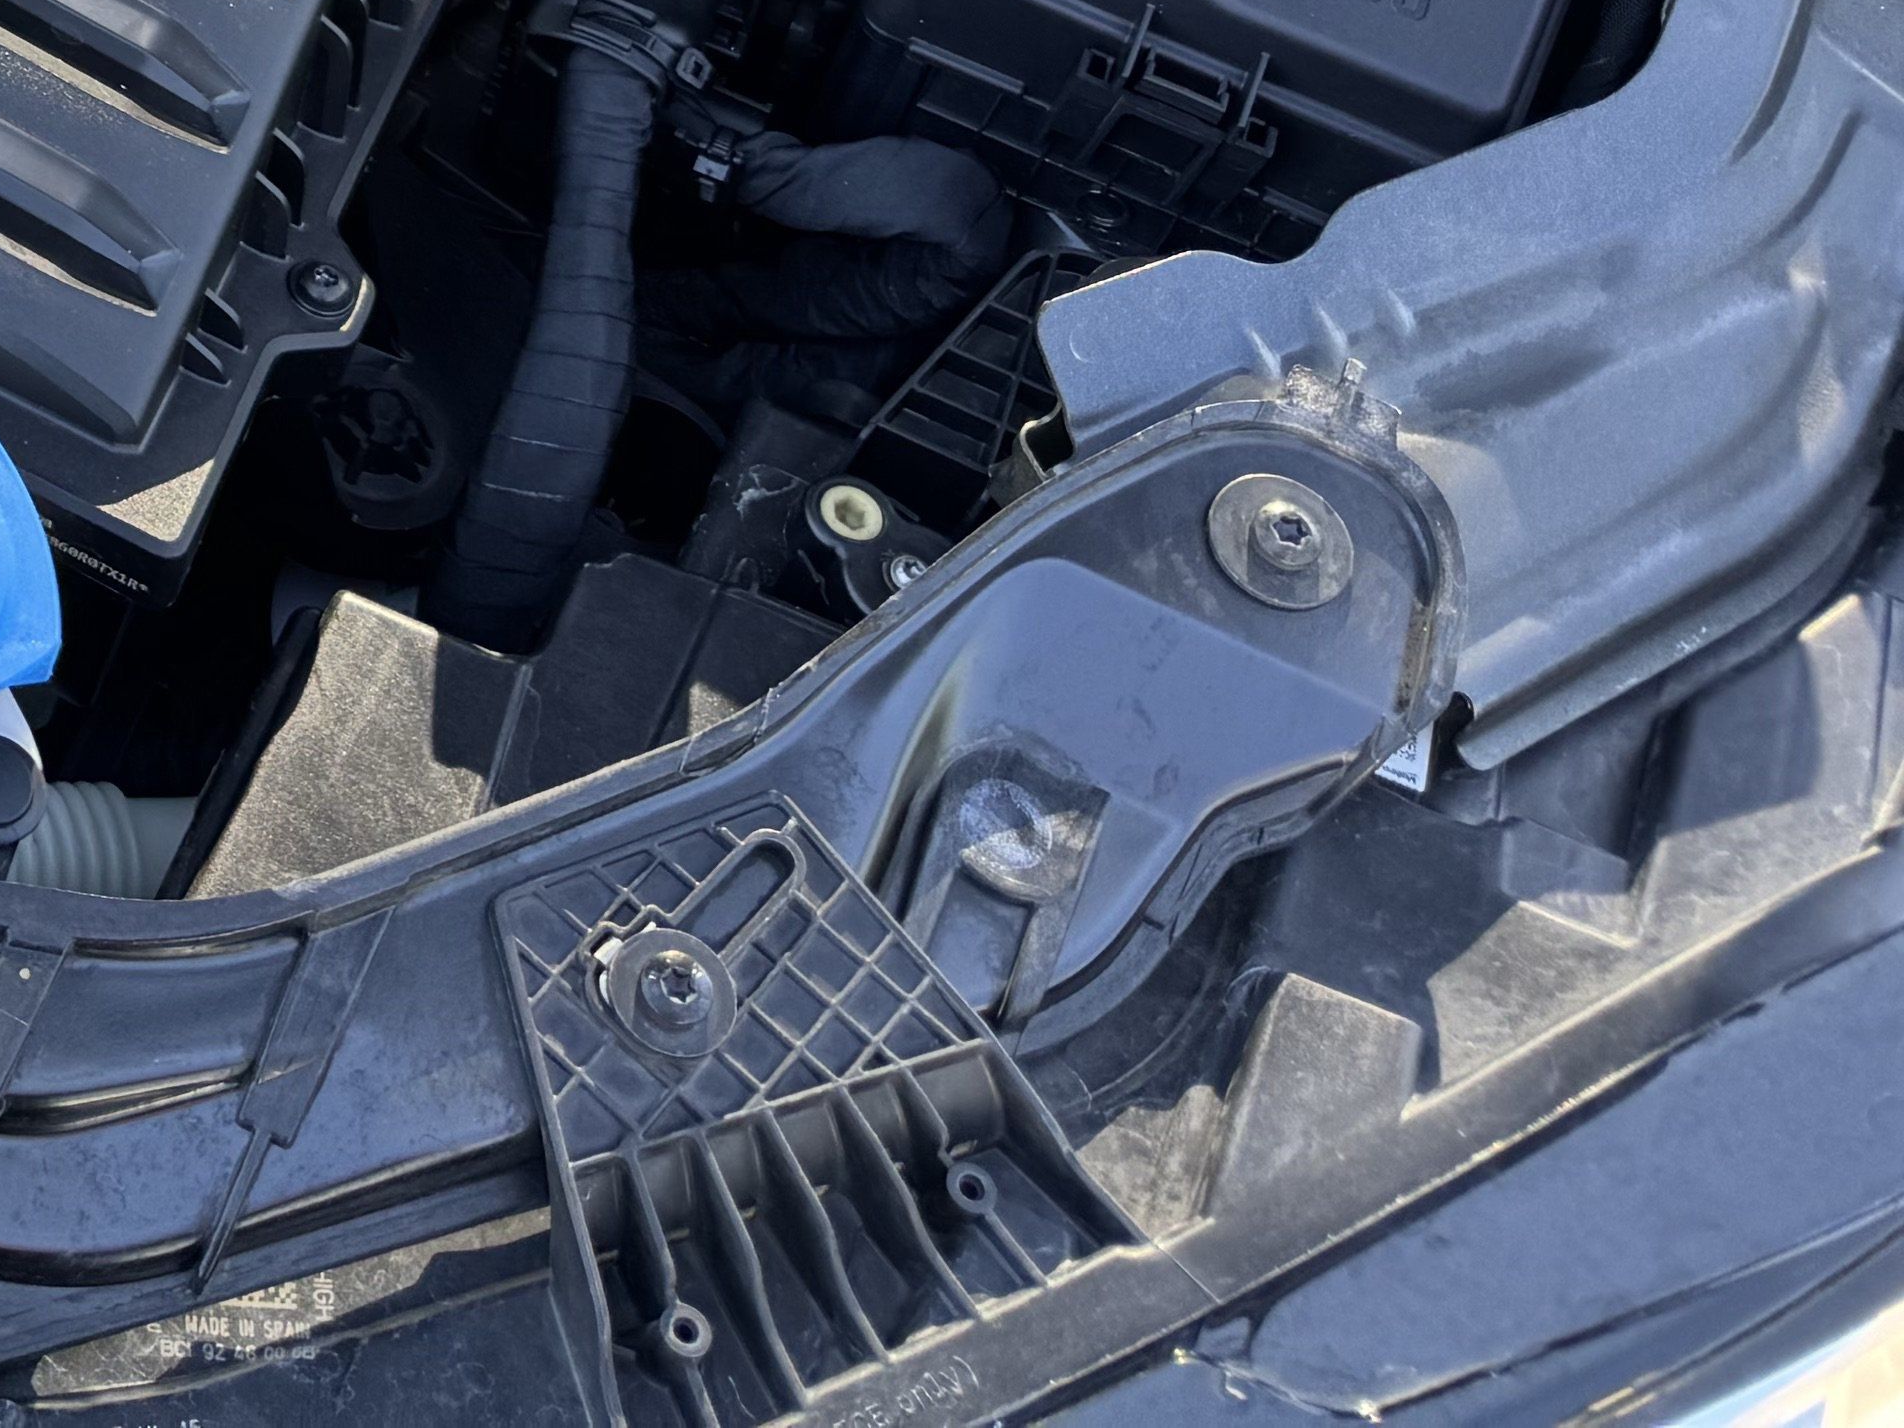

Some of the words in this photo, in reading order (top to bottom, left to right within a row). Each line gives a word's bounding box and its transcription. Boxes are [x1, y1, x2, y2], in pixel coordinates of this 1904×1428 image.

[184, 1314, 230, 1338] MADE
[238, 1317, 255, 1338] IN
[263, 1319, 311, 1340] SPAIN
